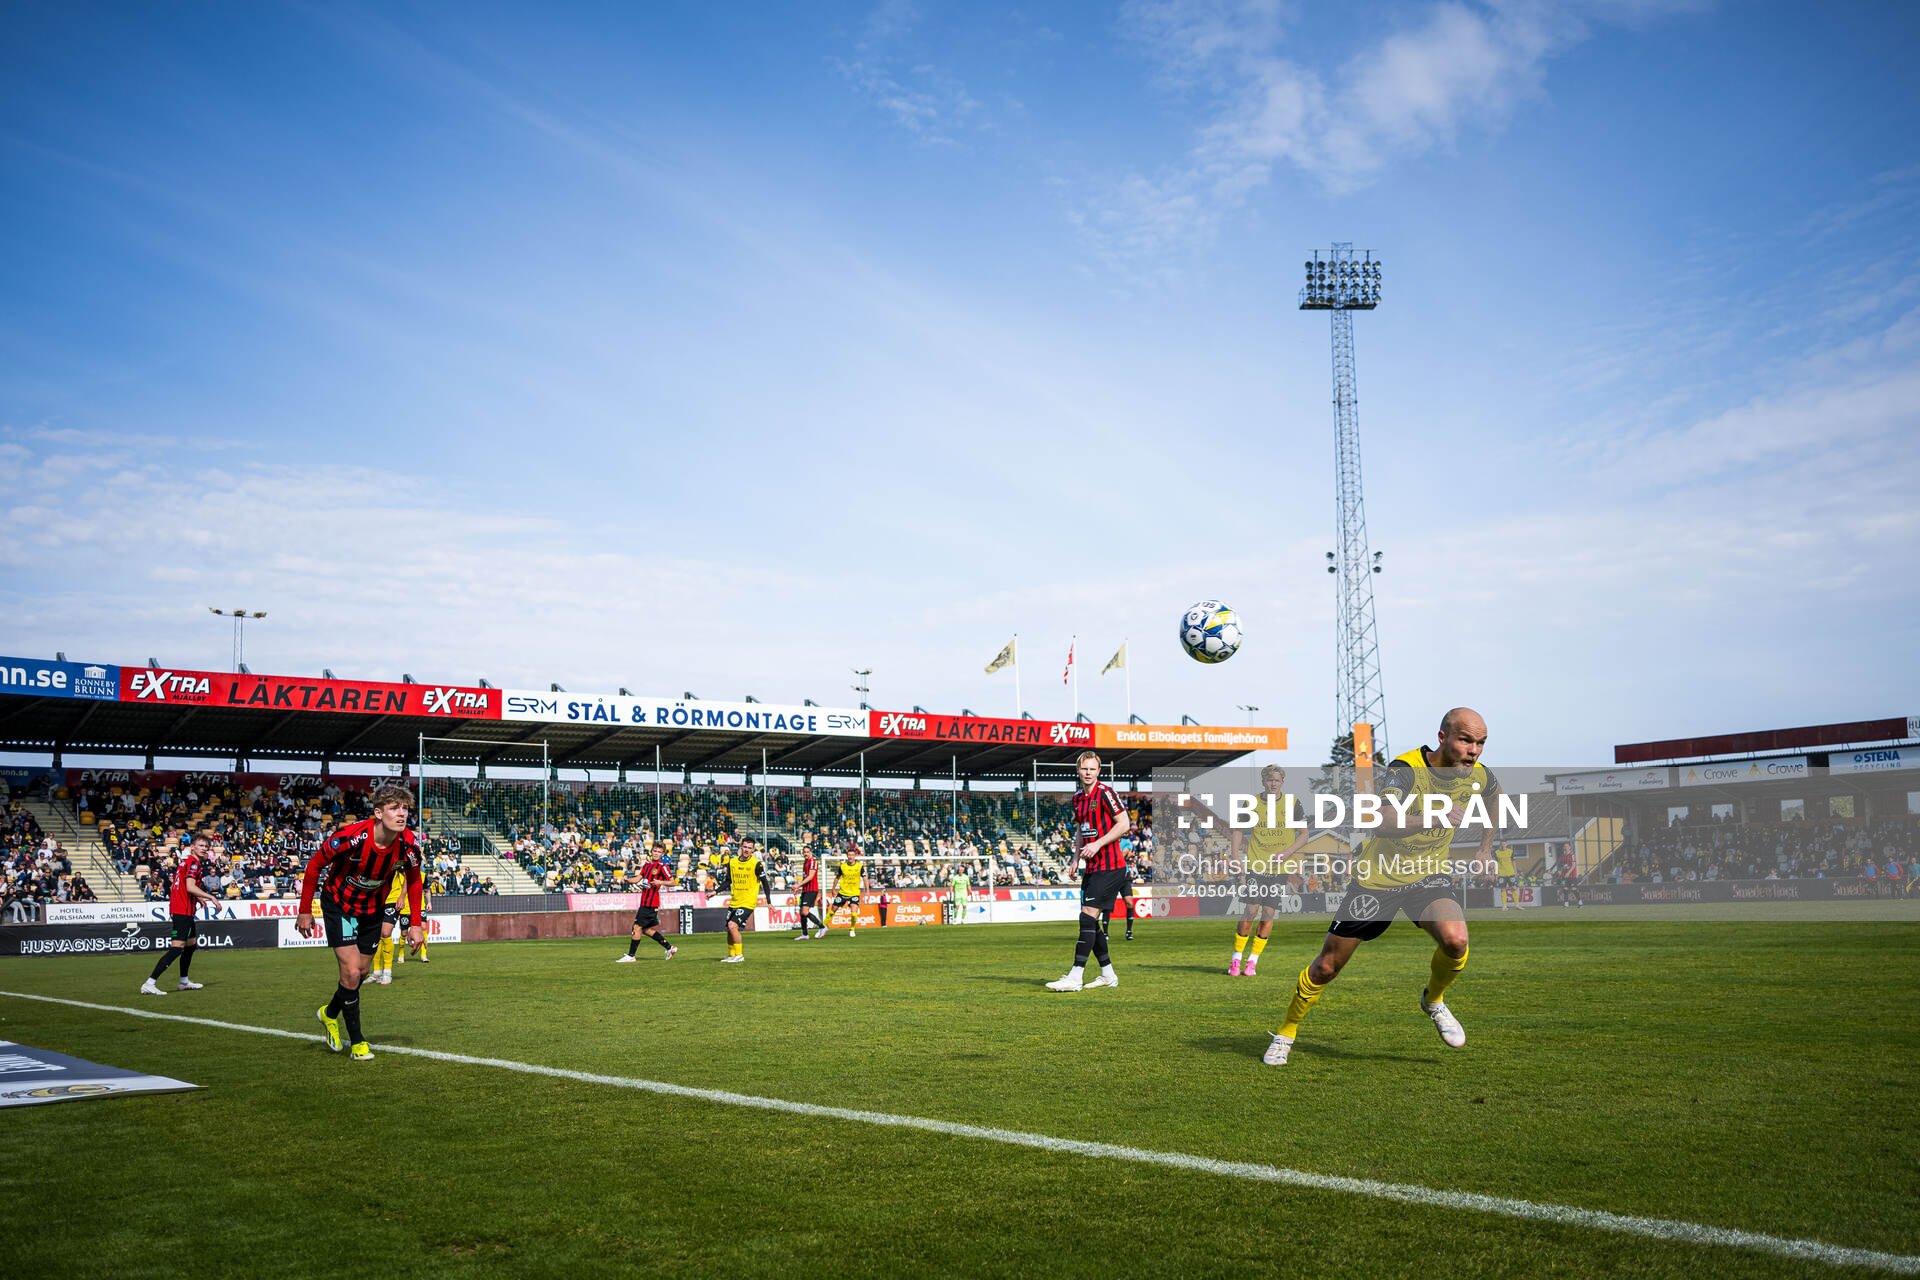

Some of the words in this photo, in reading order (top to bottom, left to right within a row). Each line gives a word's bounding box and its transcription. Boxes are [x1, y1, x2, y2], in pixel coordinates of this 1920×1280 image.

[74, 678, 116, 688] RONNEBY
[74, 686, 114, 696] BRUNN
[130, 671, 210, 700] EXTRA
[227, 678, 408, 712] LÄKTAREN
[422, 687, 488, 714] EXTRA
[507, 697, 557, 715] SRM
[567, 697, 621, 722] STÅL
[631, 705, 647, 723] &
[656, 702, 817, 732] RÖRMONTAGE
[827, 714, 866, 730] SRM
[879, 713, 926, 736] EXTRA
[935, 717, 1041, 743] LÄKTAREN
[1049, 723, 1090, 744] EXTRA
[1116, 730, 1146, 743] Enkla
[1148, 731, 1202, 745] Elbolagets
[1203, 731, 1268, 745] familjehörna
[1864, 750, 1900, 763] STENA
[1703, 768, 1738, 781] Crowe
[1767, 762, 1804, 776] Crowe
[250, 903, 298, 917] MAXI
[20, 936, 151, 953] HUSVAGNS-EXPO
[155, 934, 234, 949] BRÖLLA
